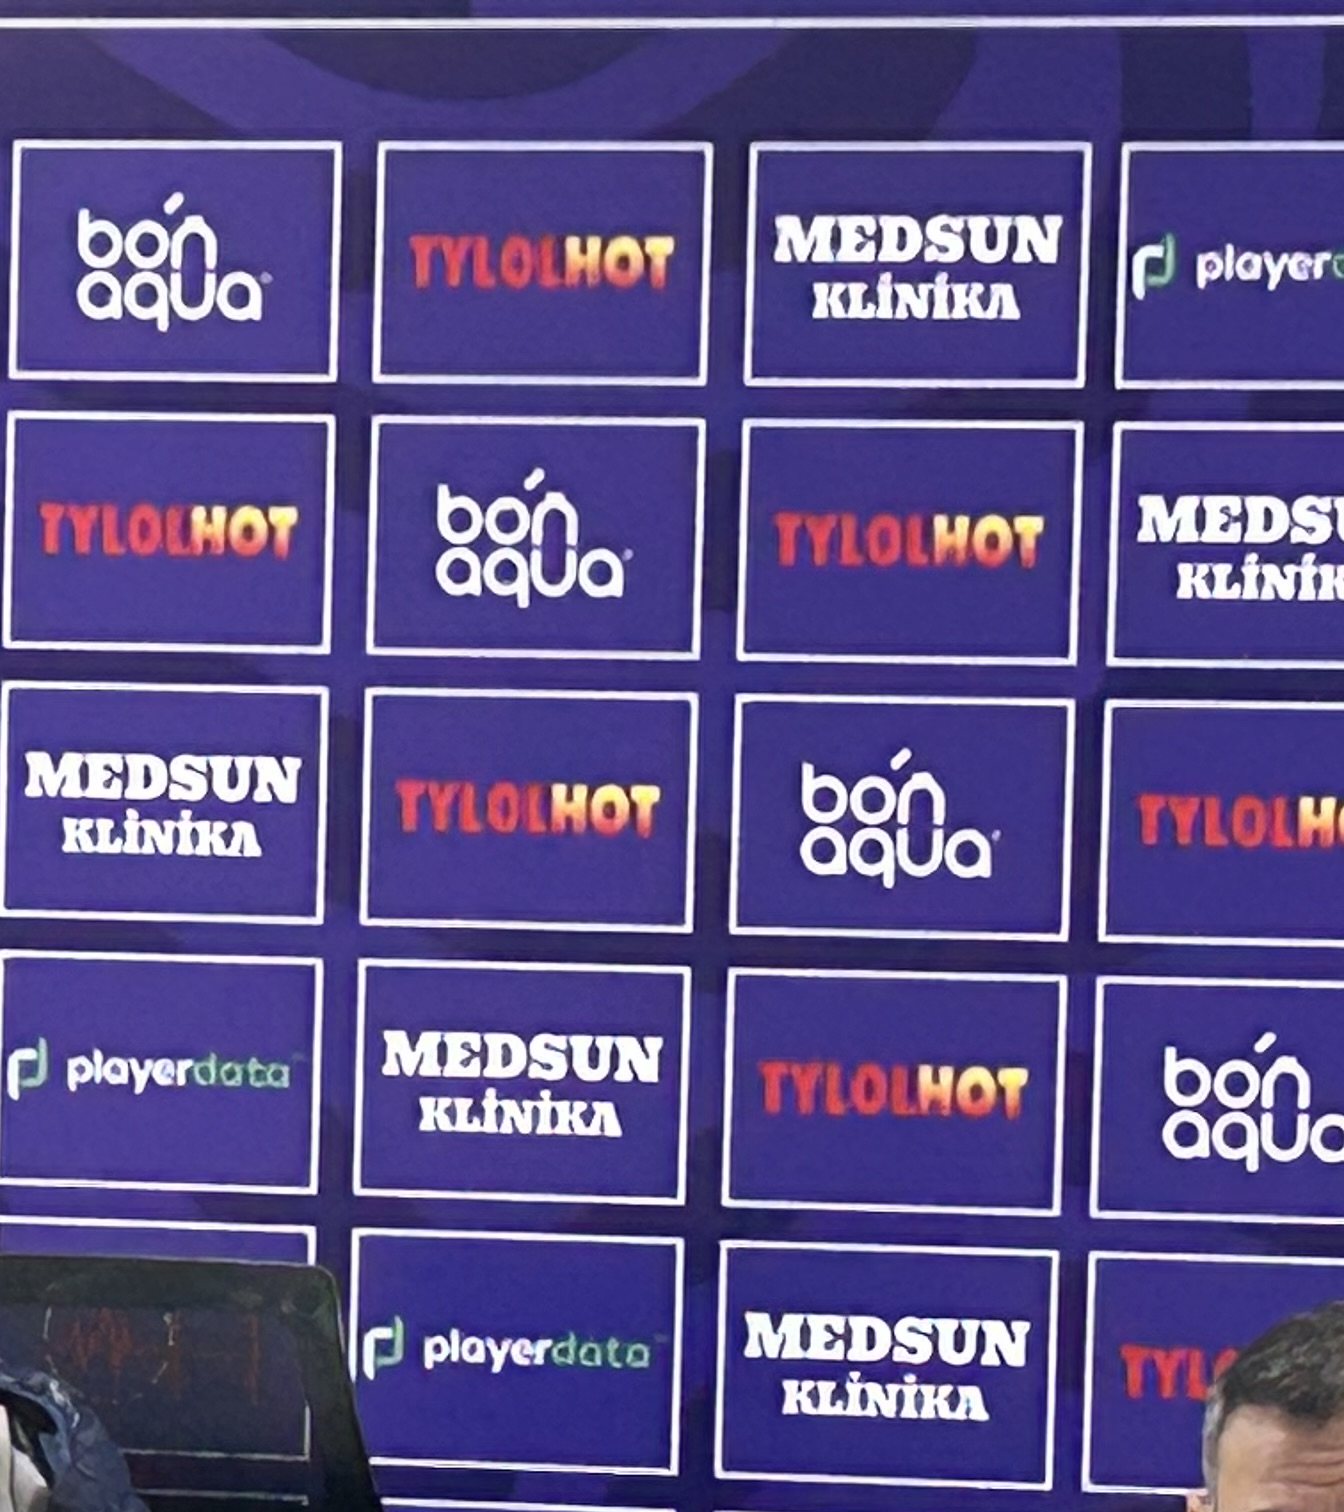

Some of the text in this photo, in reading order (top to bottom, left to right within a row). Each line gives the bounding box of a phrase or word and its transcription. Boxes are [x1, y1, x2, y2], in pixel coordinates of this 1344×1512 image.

[774, 214, 1063, 264] MEDSUN
[76, 269, 263, 332] aqua
[435, 546, 624, 608] aqua
[24, 751, 302, 804] MEDSUN
[800, 826, 992, 889] aqua
[67, 1048, 290, 1095] playerdata
[382, 1030, 663, 1083] MEDSUN
[424, 1328, 650, 1373] playerdata
[744, 1311, 1031, 1367] MEDSUN
